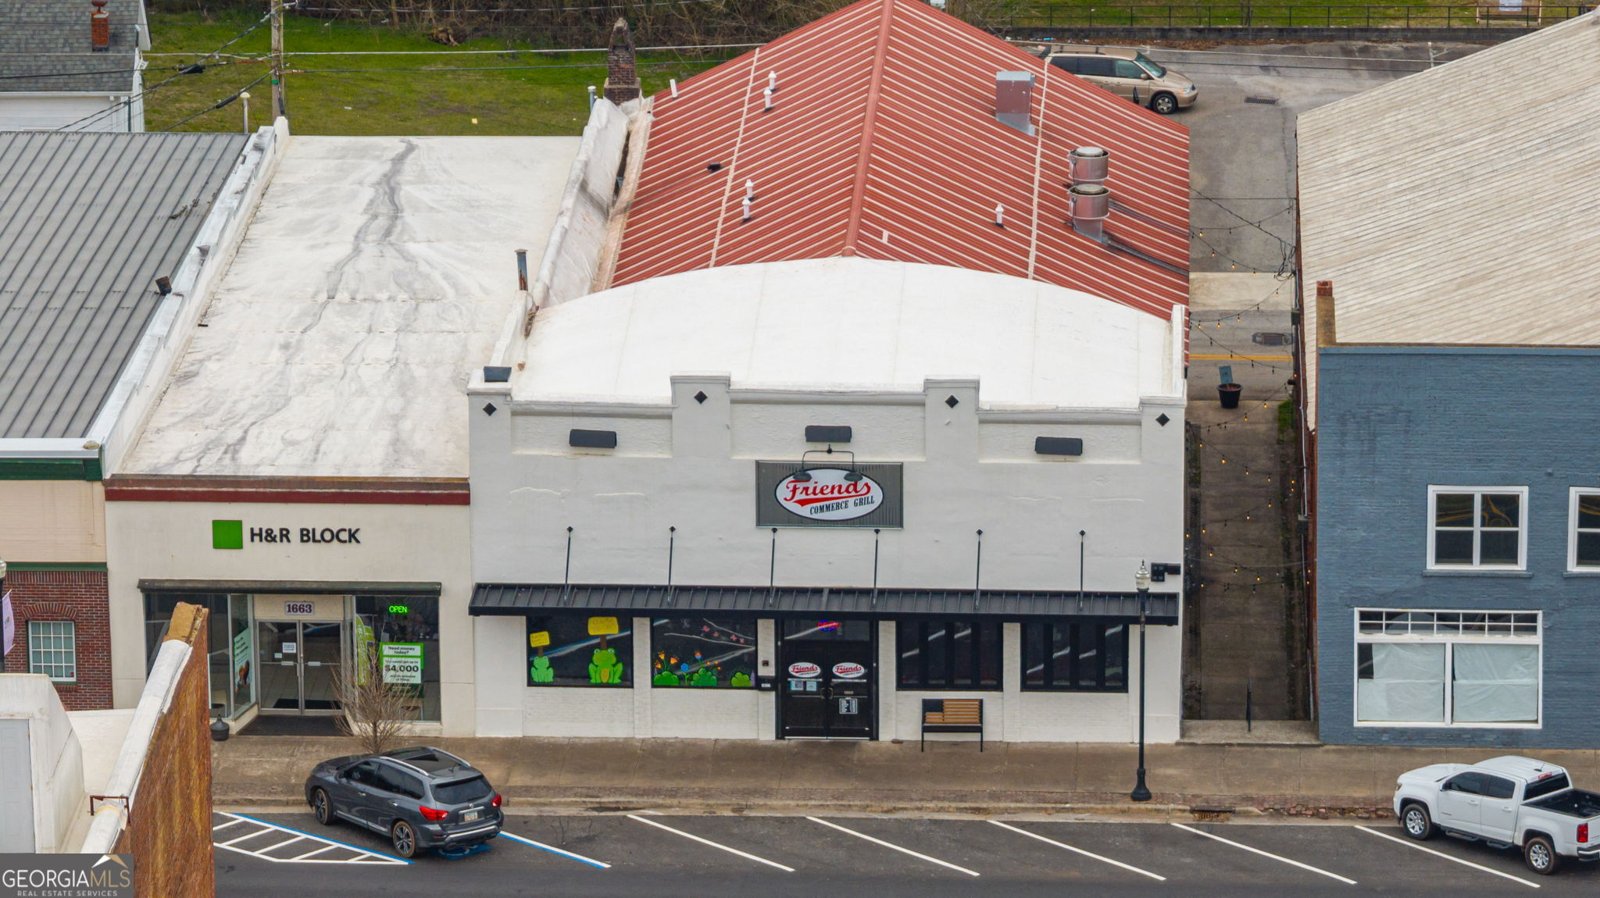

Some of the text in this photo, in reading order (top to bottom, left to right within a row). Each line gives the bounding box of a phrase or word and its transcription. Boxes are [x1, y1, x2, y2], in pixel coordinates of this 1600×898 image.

[784, 479, 872, 502] Friends
[810, 495, 875, 515] COMMERCE GRILL
[250, 527, 361, 544] H&R BLOCK
[286, 603, 313, 614] 1663
[388, 605, 408, 613] OPEN
[791, 665, 818, 674] Friends
[835, 665, 862, 674] Friends
